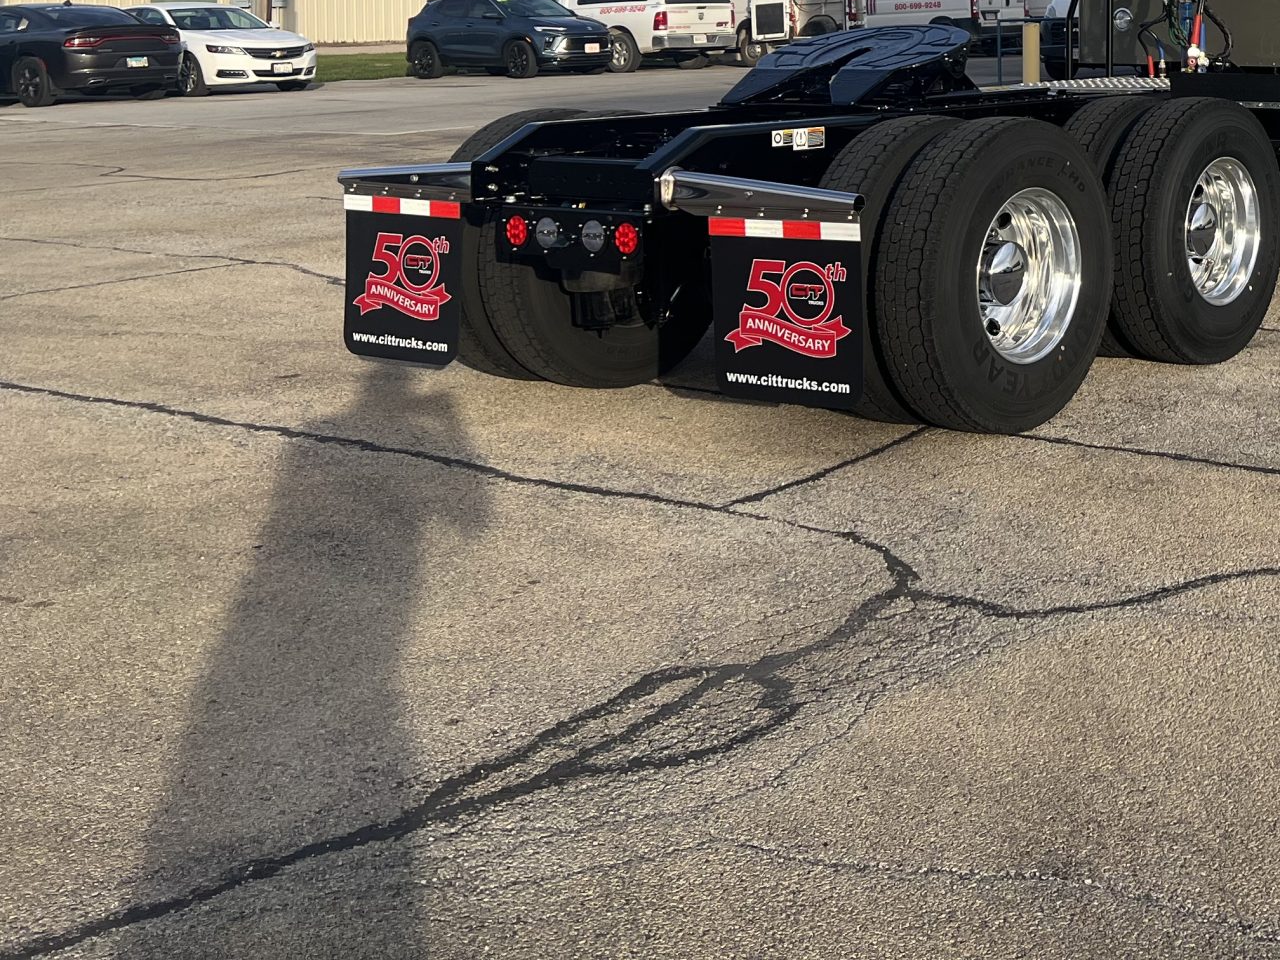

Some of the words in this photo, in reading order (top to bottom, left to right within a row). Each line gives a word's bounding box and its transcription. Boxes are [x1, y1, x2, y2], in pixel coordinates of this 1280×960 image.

[370, 284, 435, 315] ANNIVERSARY
[352, 331, 448, 353] www.cittrucks.com
[746, 317, 831, 352] ANNIVERSARY
[726, 371, 850, 394] www.cittrucks.com
